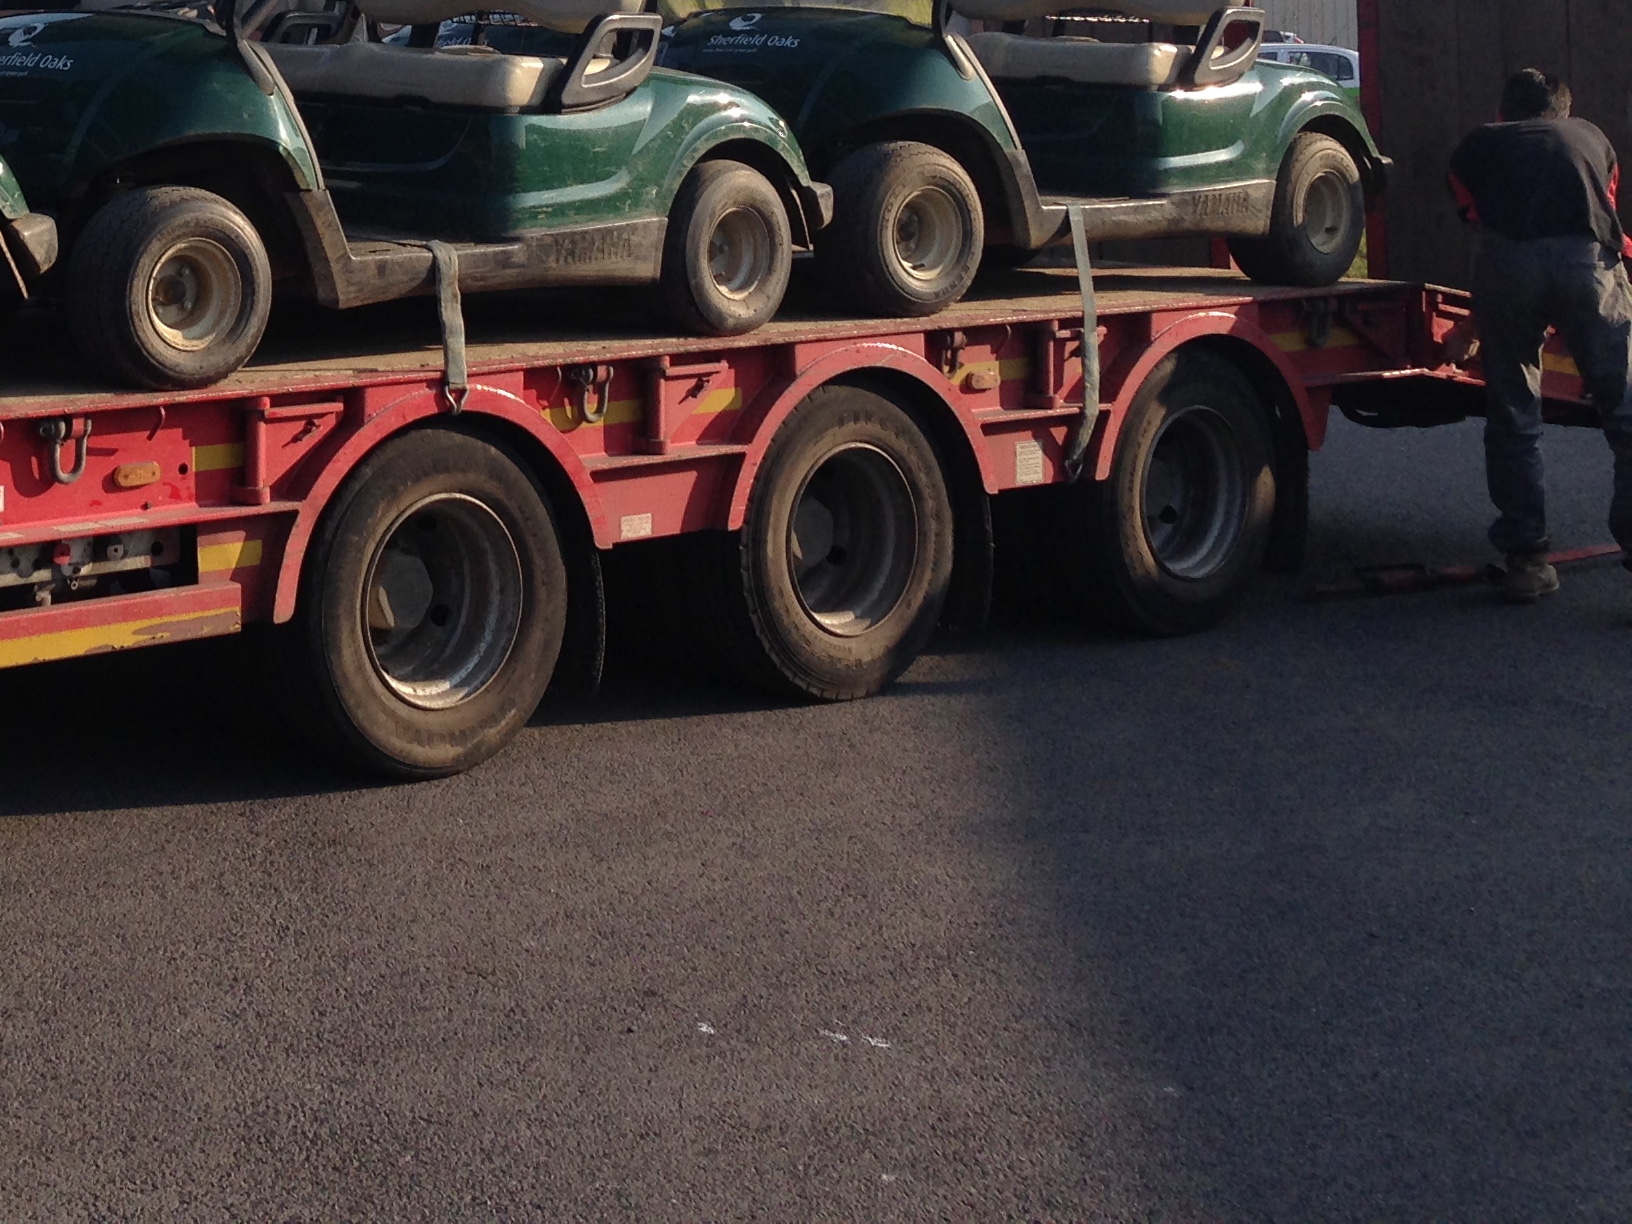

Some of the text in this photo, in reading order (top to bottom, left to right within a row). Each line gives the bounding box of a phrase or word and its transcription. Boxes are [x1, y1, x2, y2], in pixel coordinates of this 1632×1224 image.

[707, 33, 801, 48] Sherfield Oaks
[39, 54, 74, 71] Oaks
[1191, 189, 1250, 217] YAMAHA
